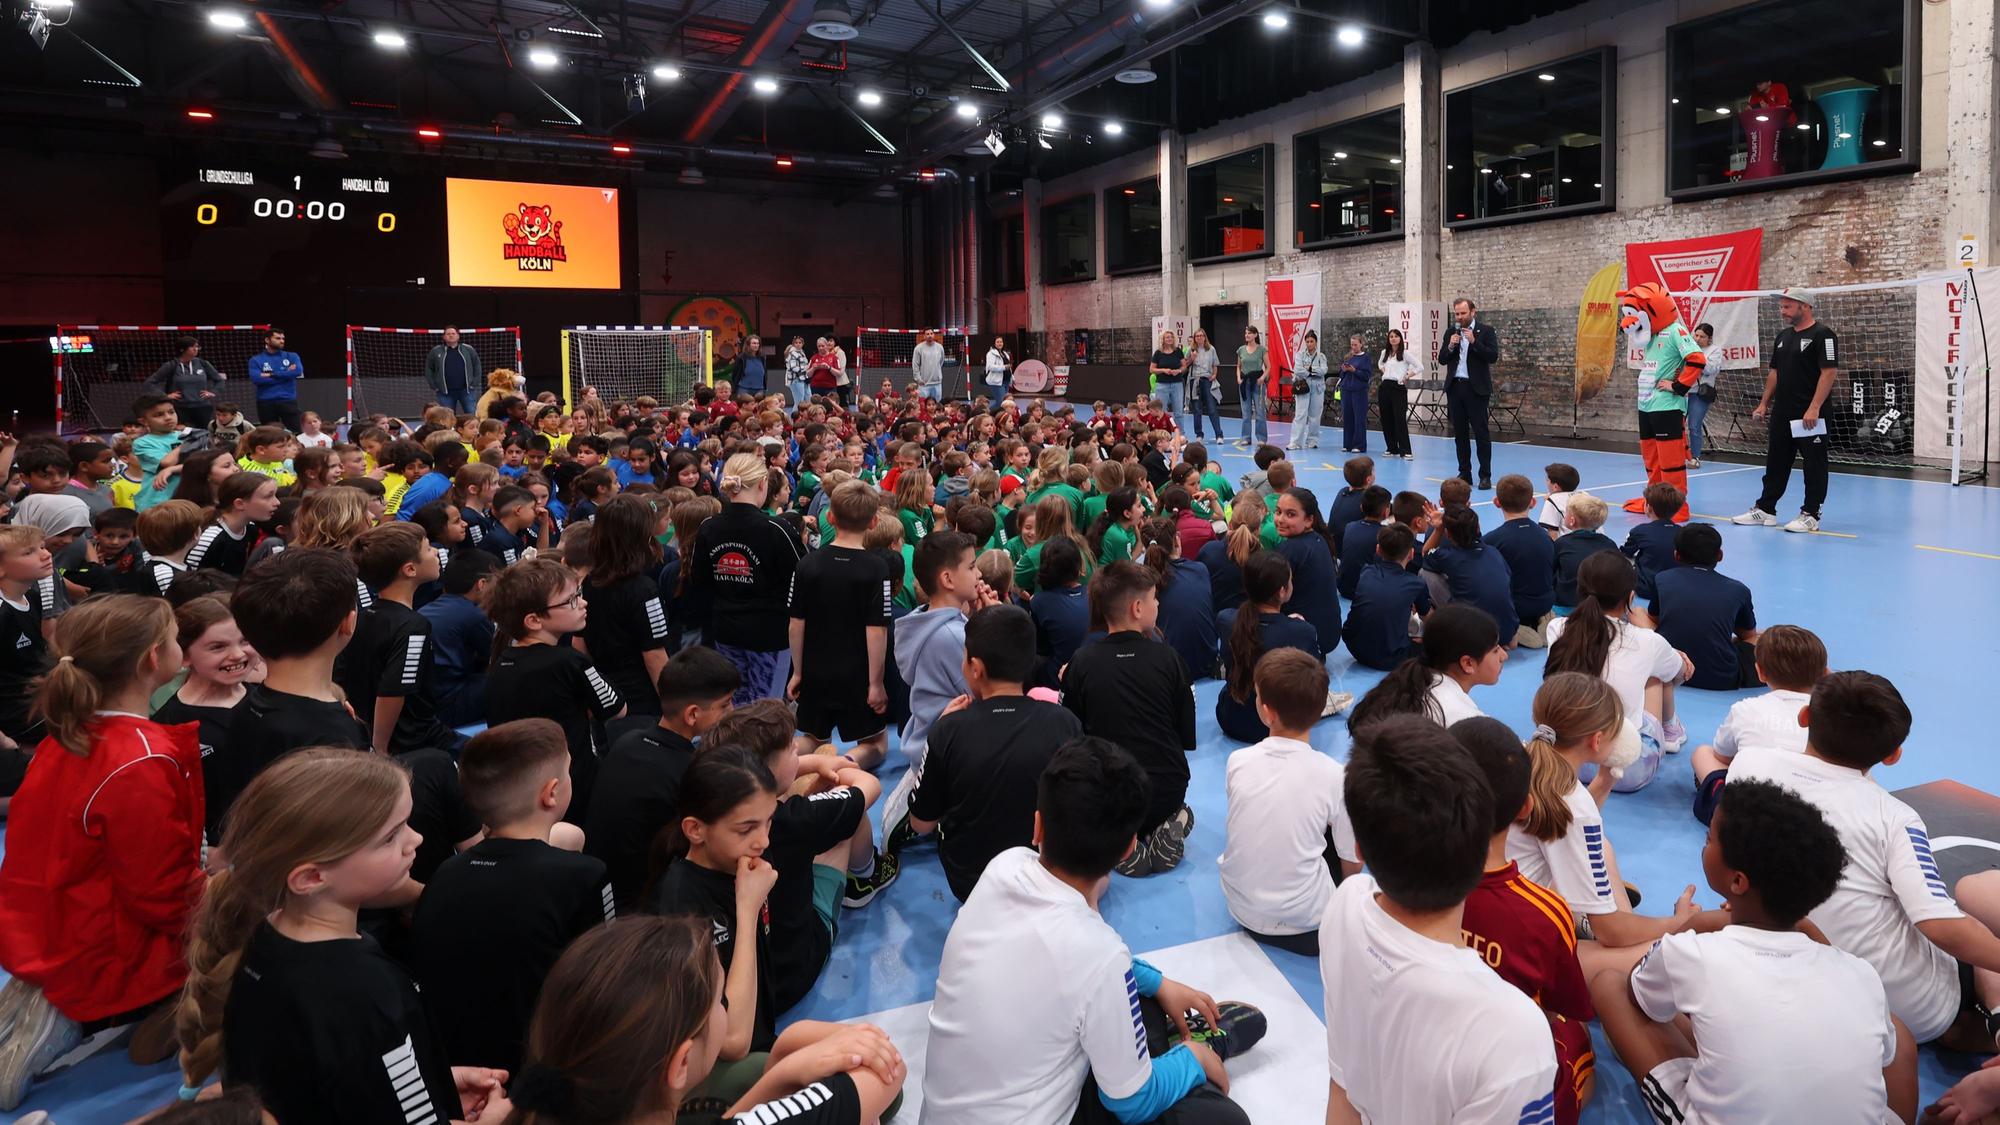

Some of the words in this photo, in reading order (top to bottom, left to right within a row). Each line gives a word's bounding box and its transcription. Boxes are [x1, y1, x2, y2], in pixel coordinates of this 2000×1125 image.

[206, 169, 254, 185] GRUNDSCHULLIGA
[293, 175, 301, 191] 1
[342, 177, 373, 192] HANDBALL
[374, 177, 390, 193] KÖLN
[196, 203, 218, 225] 0
[253, 198, 346, 221] 00:00
[377, 212, 396, 233] 0
[505, 244, 566, 260] HANDBALL
[1960, 244, 1974, 261] 2
[519, 257, 552, 270] KÖLN
[1664, 260, 1703, 268] Longericher
[1853, 382, 1864, 415] SELECT
